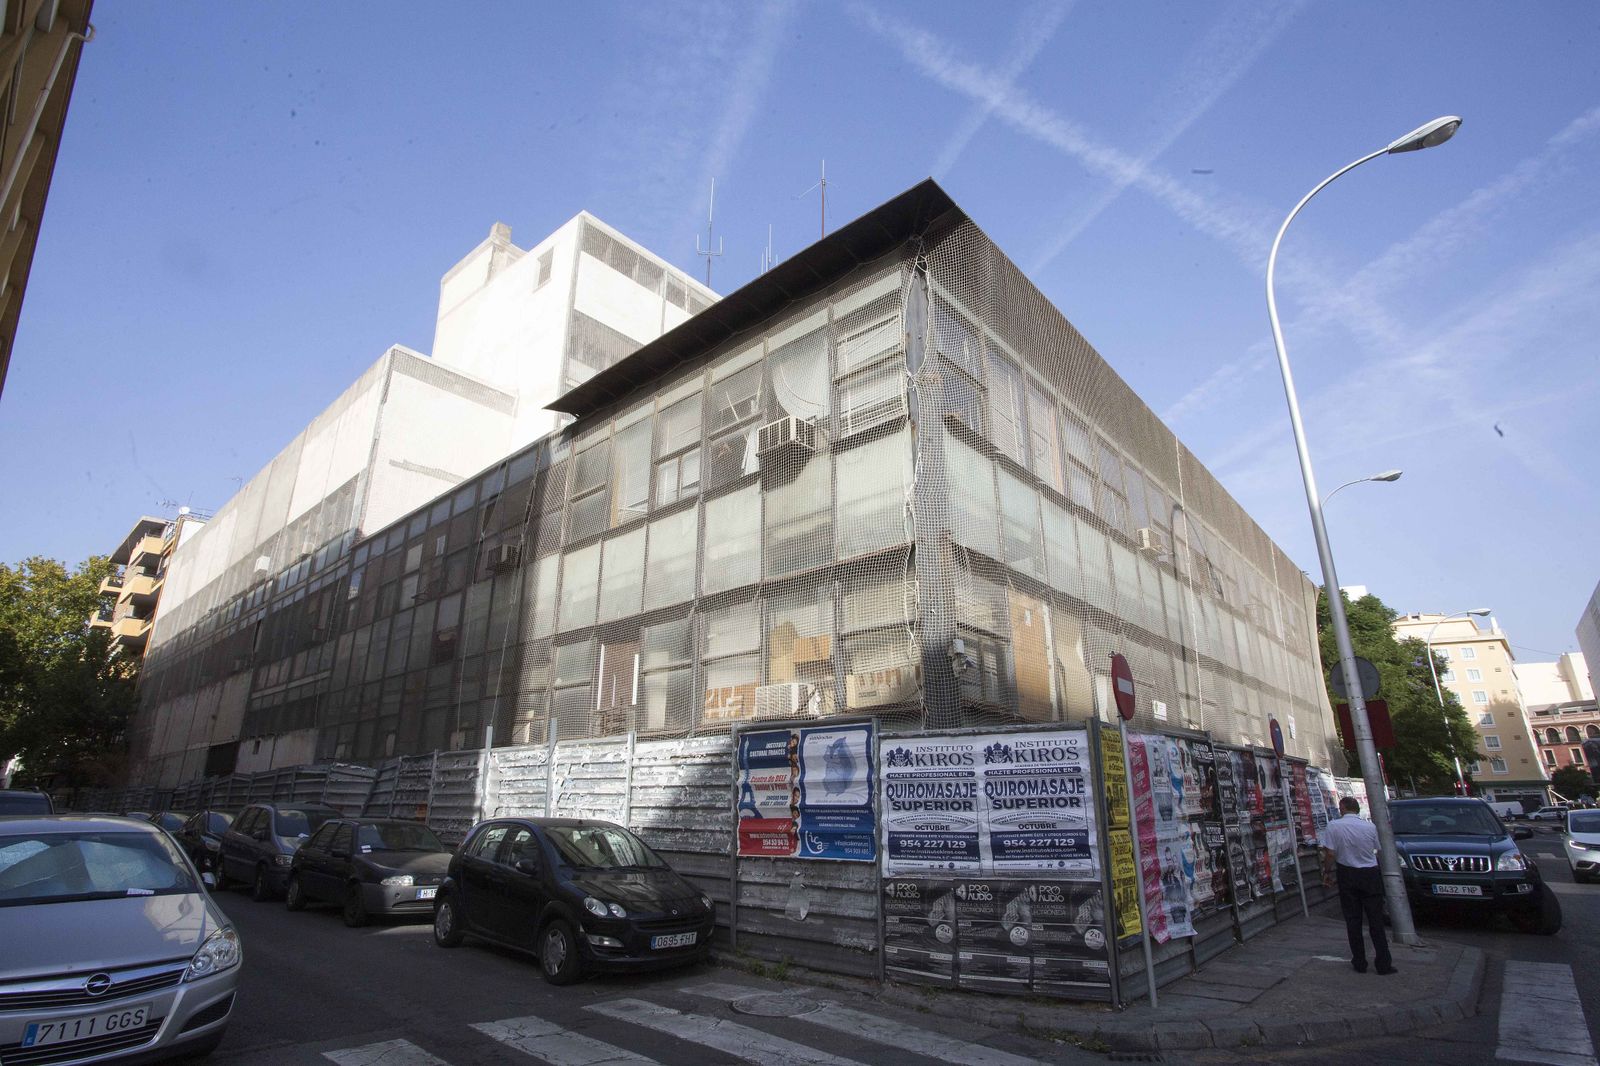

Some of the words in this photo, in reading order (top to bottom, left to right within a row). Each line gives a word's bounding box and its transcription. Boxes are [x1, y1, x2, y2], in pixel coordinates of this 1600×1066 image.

[1015, 739, 1078, 748] INSTITUTO
[914, 752, 974, 767] KIROS
[1014, 747, 1079, 763] KIROS
[886, 783, 977, 801] QUIROMASAJE
[985, 778, 1085, 800] QUIROMASAJE
[892, 801, 974, 811] SUPERIOR
[992, 797, 1082, 809] SUPERIOR
[969, 885, 989, 893] PRO
[1039, 886, 1060, 895] PRO
[1439, 885, 1458, 893] 8432
[1015, 928, 1025, 936] 2x1
[38, 1018, 96, 1042] 7111
[106, 1010, 144, 1031] GGS
